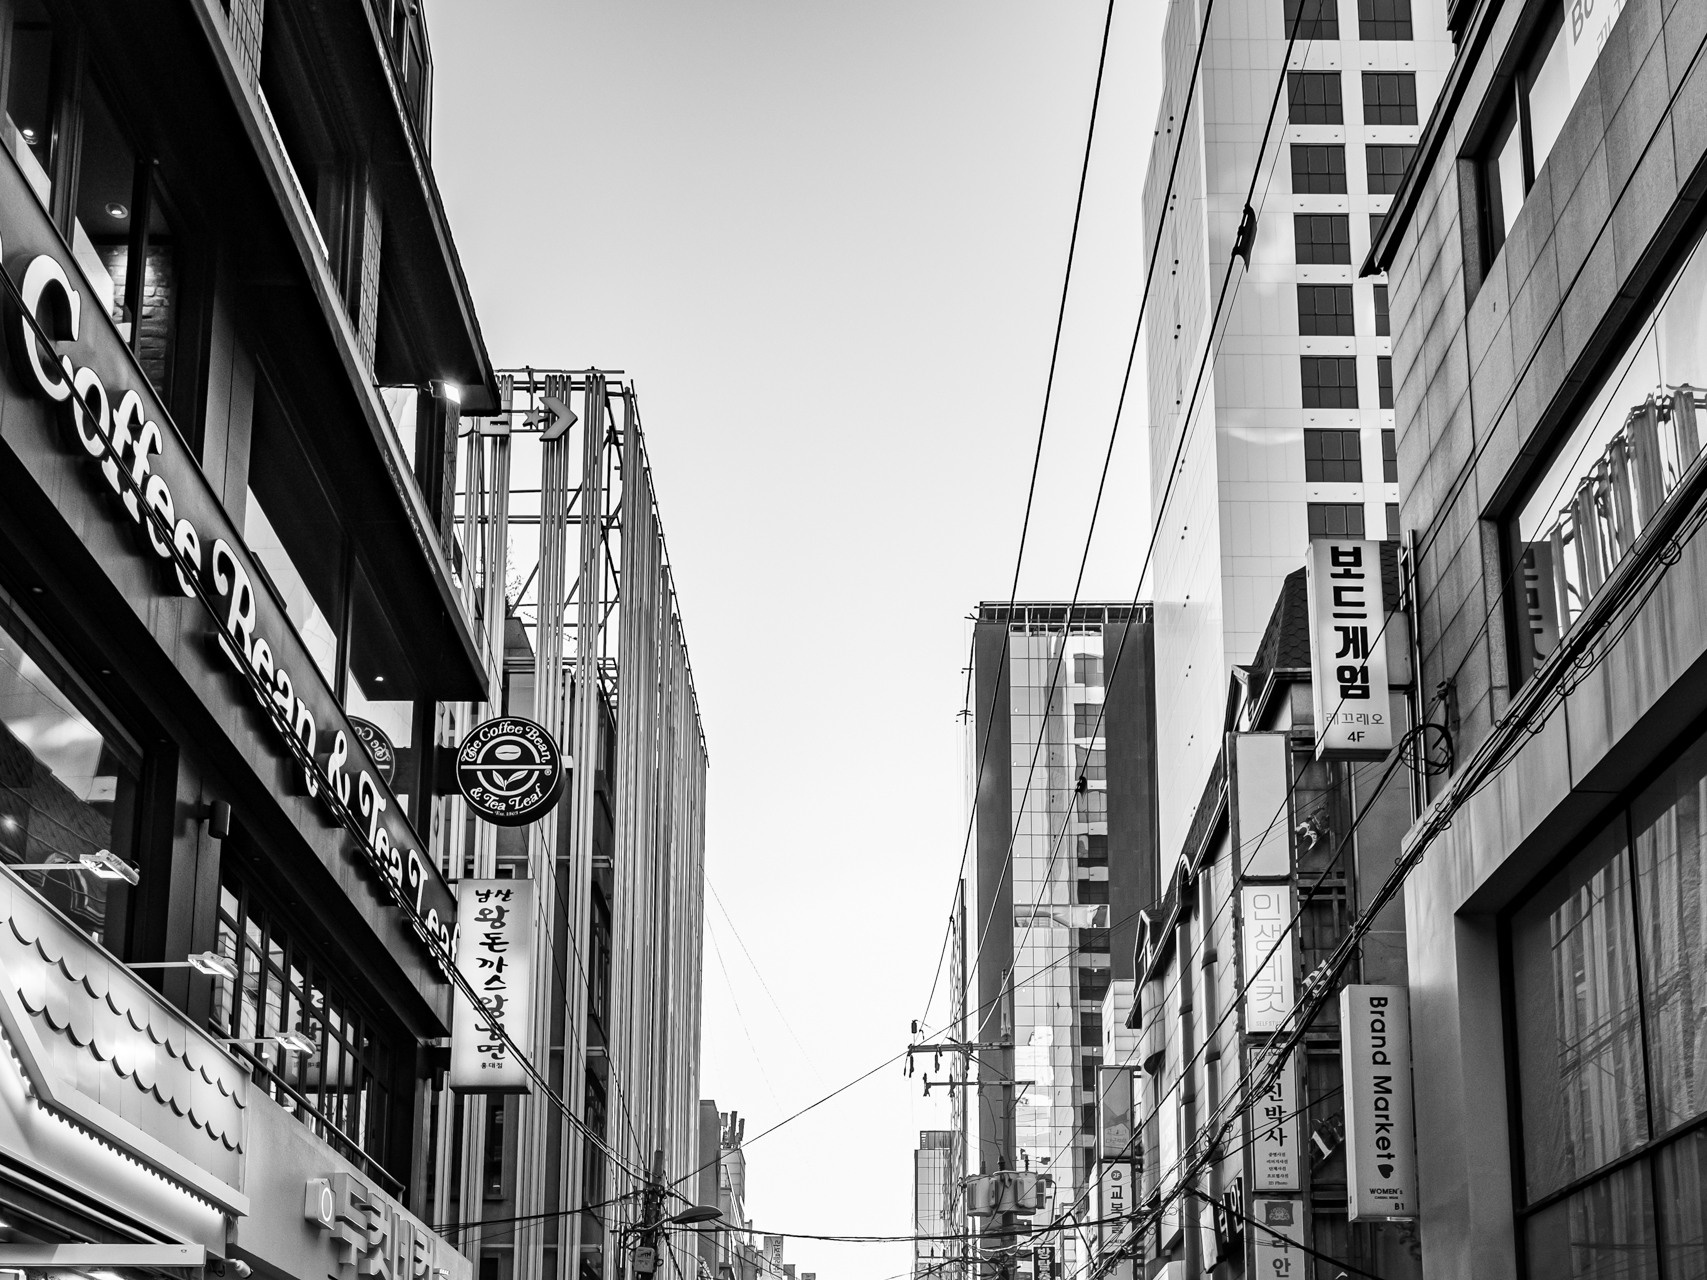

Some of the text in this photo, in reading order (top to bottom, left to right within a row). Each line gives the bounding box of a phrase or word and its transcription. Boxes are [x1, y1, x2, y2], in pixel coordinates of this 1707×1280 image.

[22, 254, 462, 986] Coffee Bean & Tea Leaf
[1330, 546, 1370, 699] 보드게임
[461, 721, 552, 763] The Coffee Bean
[1347, 731, 1365, 742] 4F
[470, 783, 544, 811] & Tea Leaf
[475, 889, 514, 903] 남산
[474, 905, 511, 991] 왕돈까스
[1253, 893, 1286, 1013] 인생네컷
[1369, 997, 1396, 1159] Brand Market
[1112, 1171, 1121, 1179] 2F
[1394, 1202, 1405, 1210] B1
